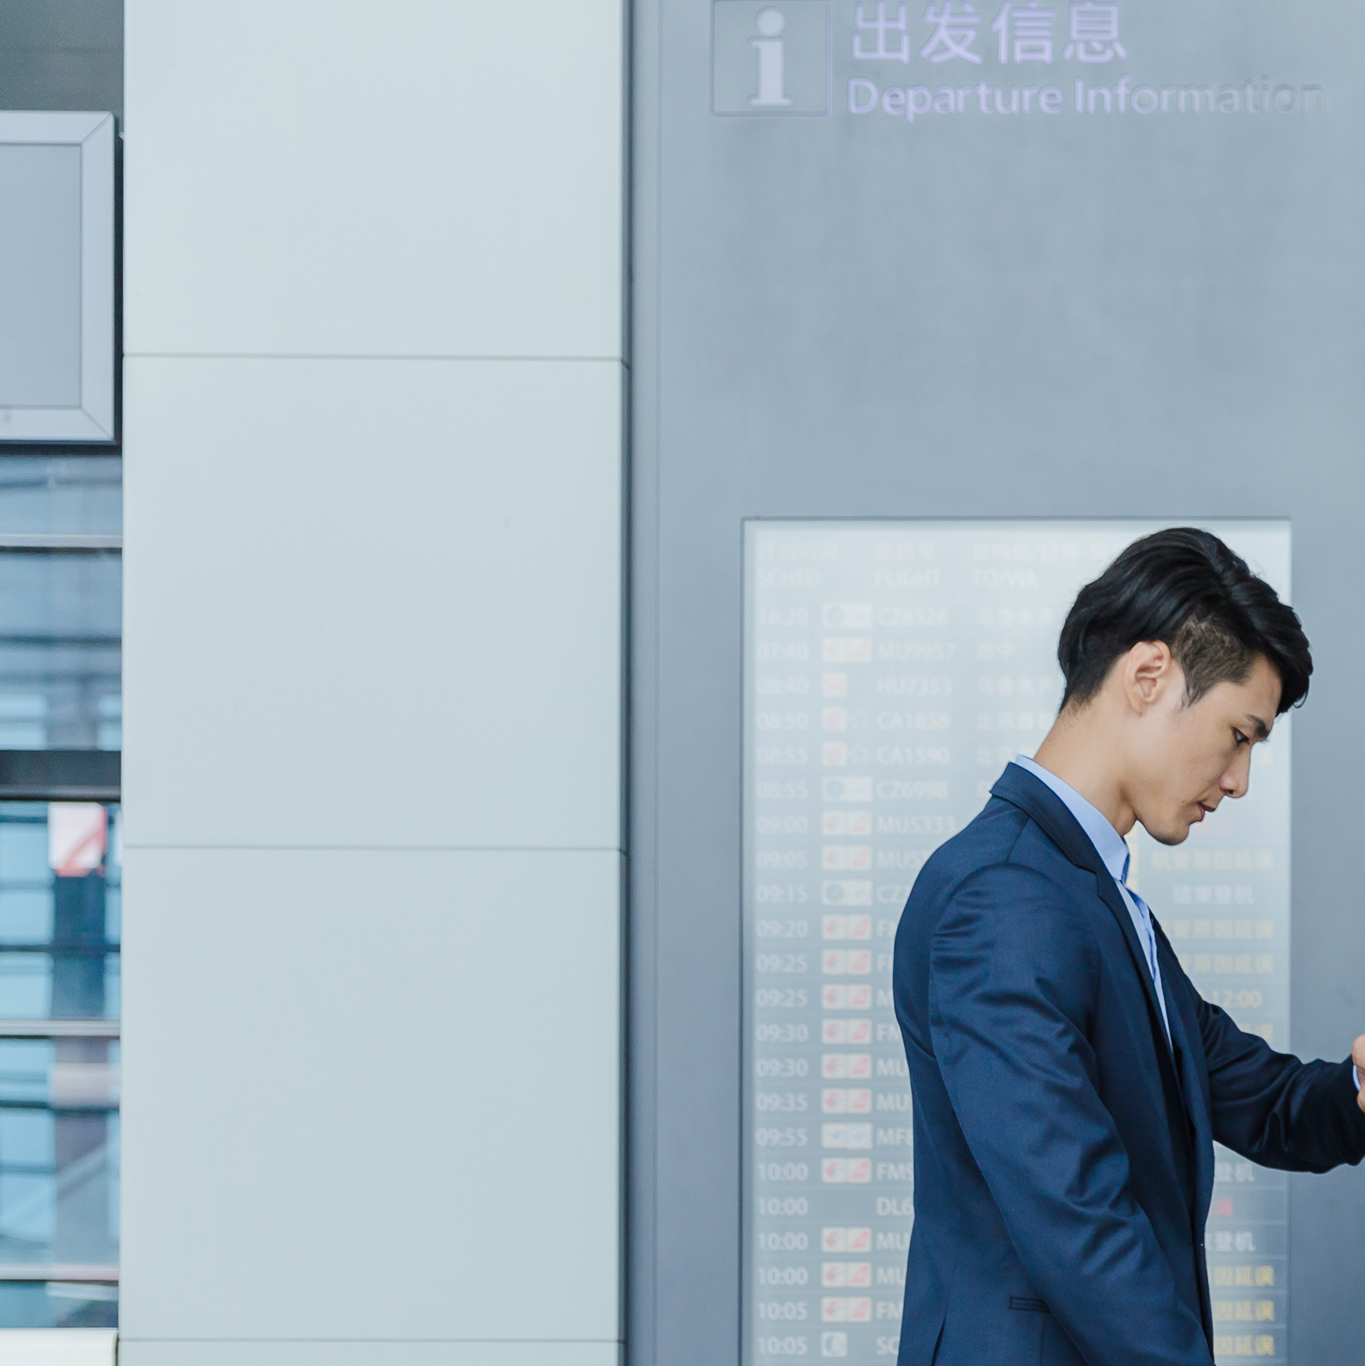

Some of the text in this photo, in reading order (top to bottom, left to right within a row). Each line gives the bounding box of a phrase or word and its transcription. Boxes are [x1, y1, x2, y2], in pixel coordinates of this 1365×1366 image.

[853, 0, 1127, 63] 出发信息
[849, 74, 1324, 121] Departure Information
[758, 1163, 808, 1181] 10:00
[758, 1197, 808, 1215] 10:00
[759, 1232, 808, 1250] 10:00
[758, 1267, 808, 1285] 10:00
[758, 1302, 807, 1320] 10:05
[759, 1336, 807, 1355] 10:05
